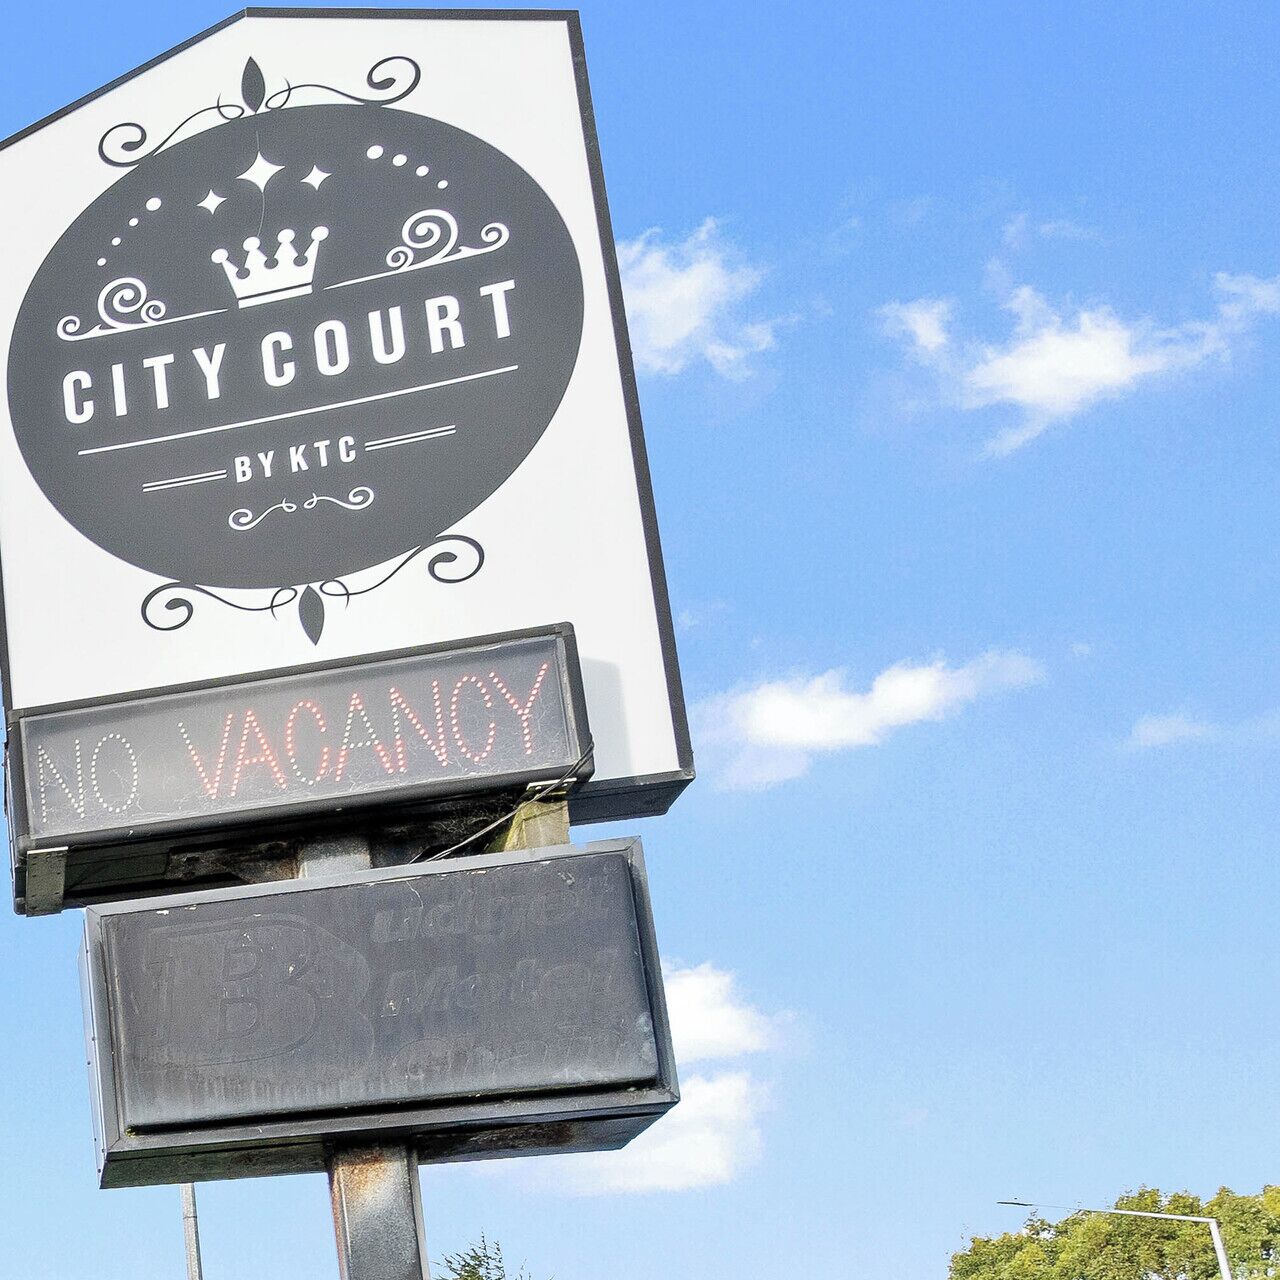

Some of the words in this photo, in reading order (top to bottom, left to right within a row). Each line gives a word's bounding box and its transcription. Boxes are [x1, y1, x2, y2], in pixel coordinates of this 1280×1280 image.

[61, 341, 228, 426] CITY
[260, 278, 517, 388] COURT
[233, 450, 276, 484] BY
[288, 434, 358, 474] KTC
[38, 731, 139, 824] NO
[176, 662, 549, 801] VACANCY
